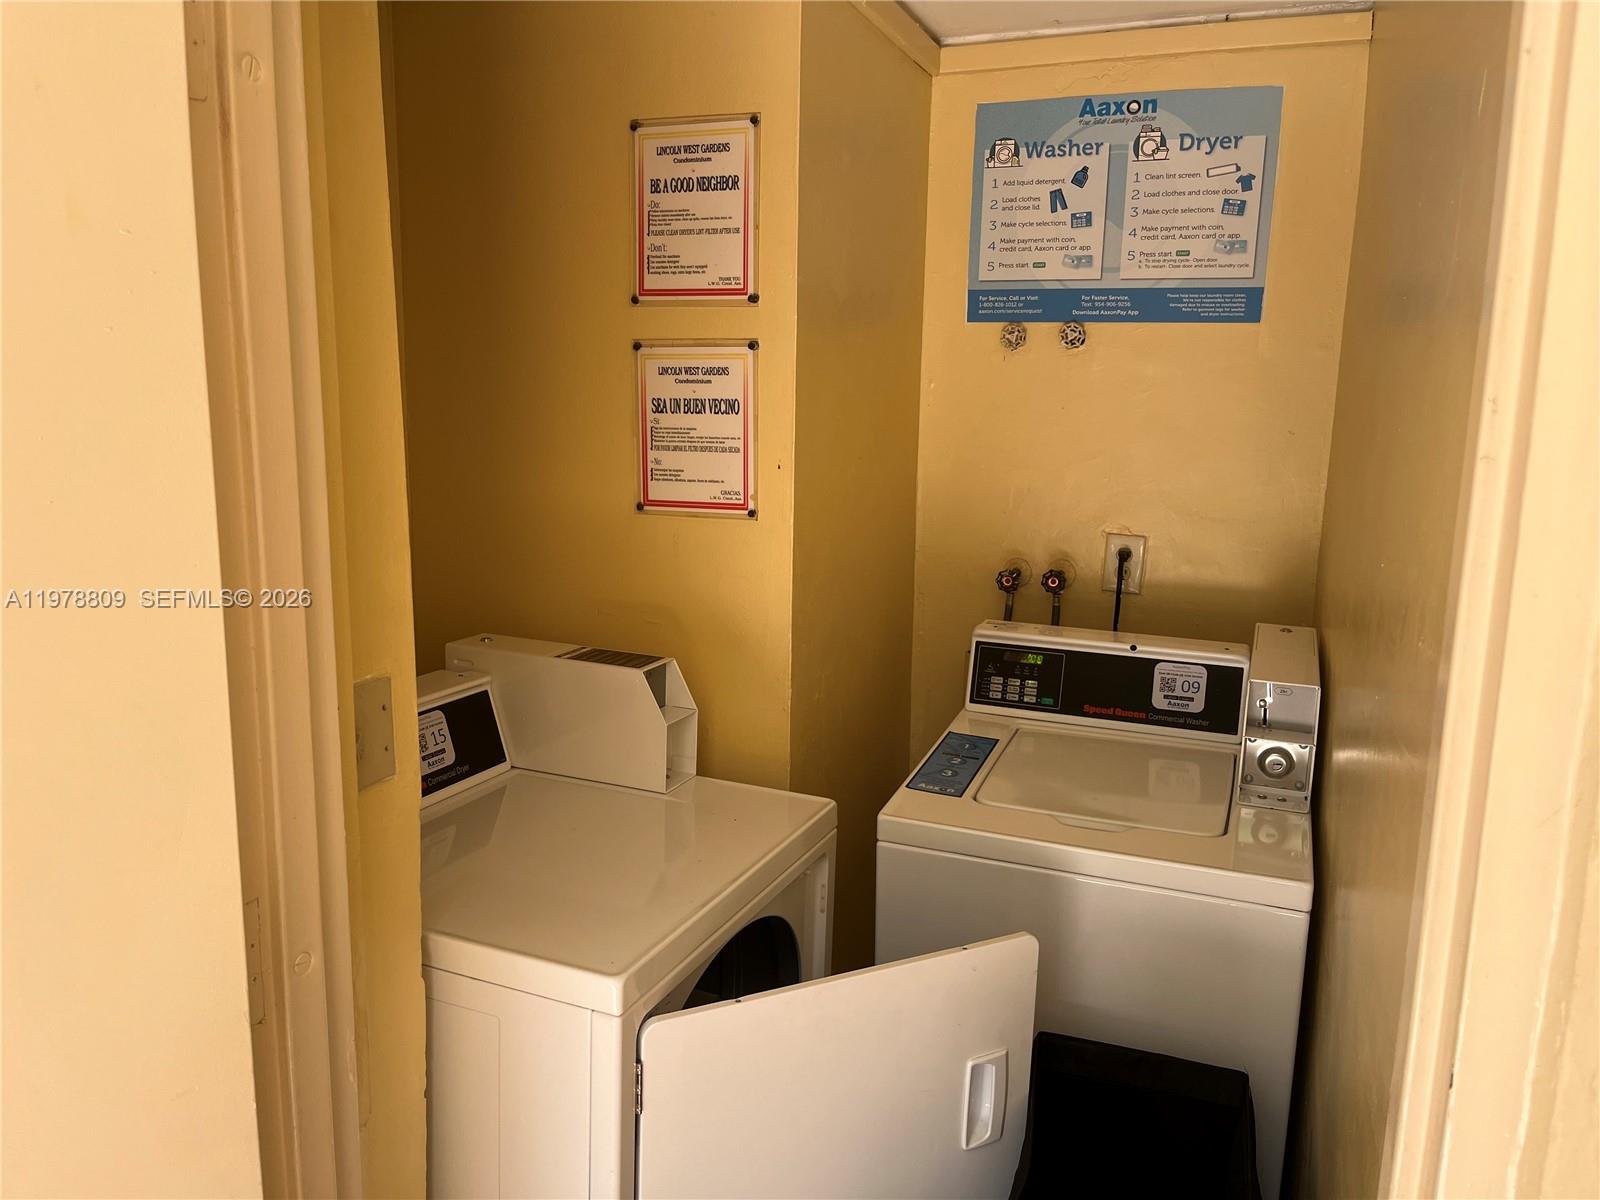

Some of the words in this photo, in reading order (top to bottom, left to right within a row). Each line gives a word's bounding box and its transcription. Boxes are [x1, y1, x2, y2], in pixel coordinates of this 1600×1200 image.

[1079, 98, 1157, 117] Aaxon
[656, 146, 681, 156] LINCOLN
[683, 145, 700, 154] WEST
[701, 143, 730, 153] GARDENS
[1024, 138, 1104, 159] Washer
[1179, 132, 1243, 155] Dryer
[992, 179, 998, 188] 1
[1134, 172, 1140, 183] 1
[650, 179, 661, 194] BE
[663, 179, 669, 193] A
[670, 177, 694, 193] GOOD
[696, 175, 739, 192] NEIGHBOR
[1131, 190, 1140, 200] 2
[990, 200, 998, 210] 2
[1130, 207, 1139, 217] 3
[1162, 208, 1179, 216] cycle
[989, 221, 997, 230] 3
[1128, 228, 1137, 238] 4
[1160, 225, 1190, 233] payment
[988, 241, 996, 251] 4
[1017, 238, 1044, 246] payment
[1128, 250, 1136, 261] 5
[987, 261, 995, 271] 5
[658, 366, 682, 375] LINCOLN
[684, 366, 700, 375] WEST
[701, 366, 729, 376] GARDENS
[652, 398, 667, 414] SEA
[670, 398, 681, 414] UN
[684, 398, 706, 414] BUEN
[708, 398, 740, 415] VECINO
[1182, 680, 1200, 694] 09
[1168, 700, 1190, 708] Aaxon
[1083, 704, 1113, 714] Speed
[1114, 708, 1146, 719] Queen
[1148, 713, 1184, 723] Commercial
[1186, 718, 1209, 727] Washer
[431, 728, 446, 746] 15
